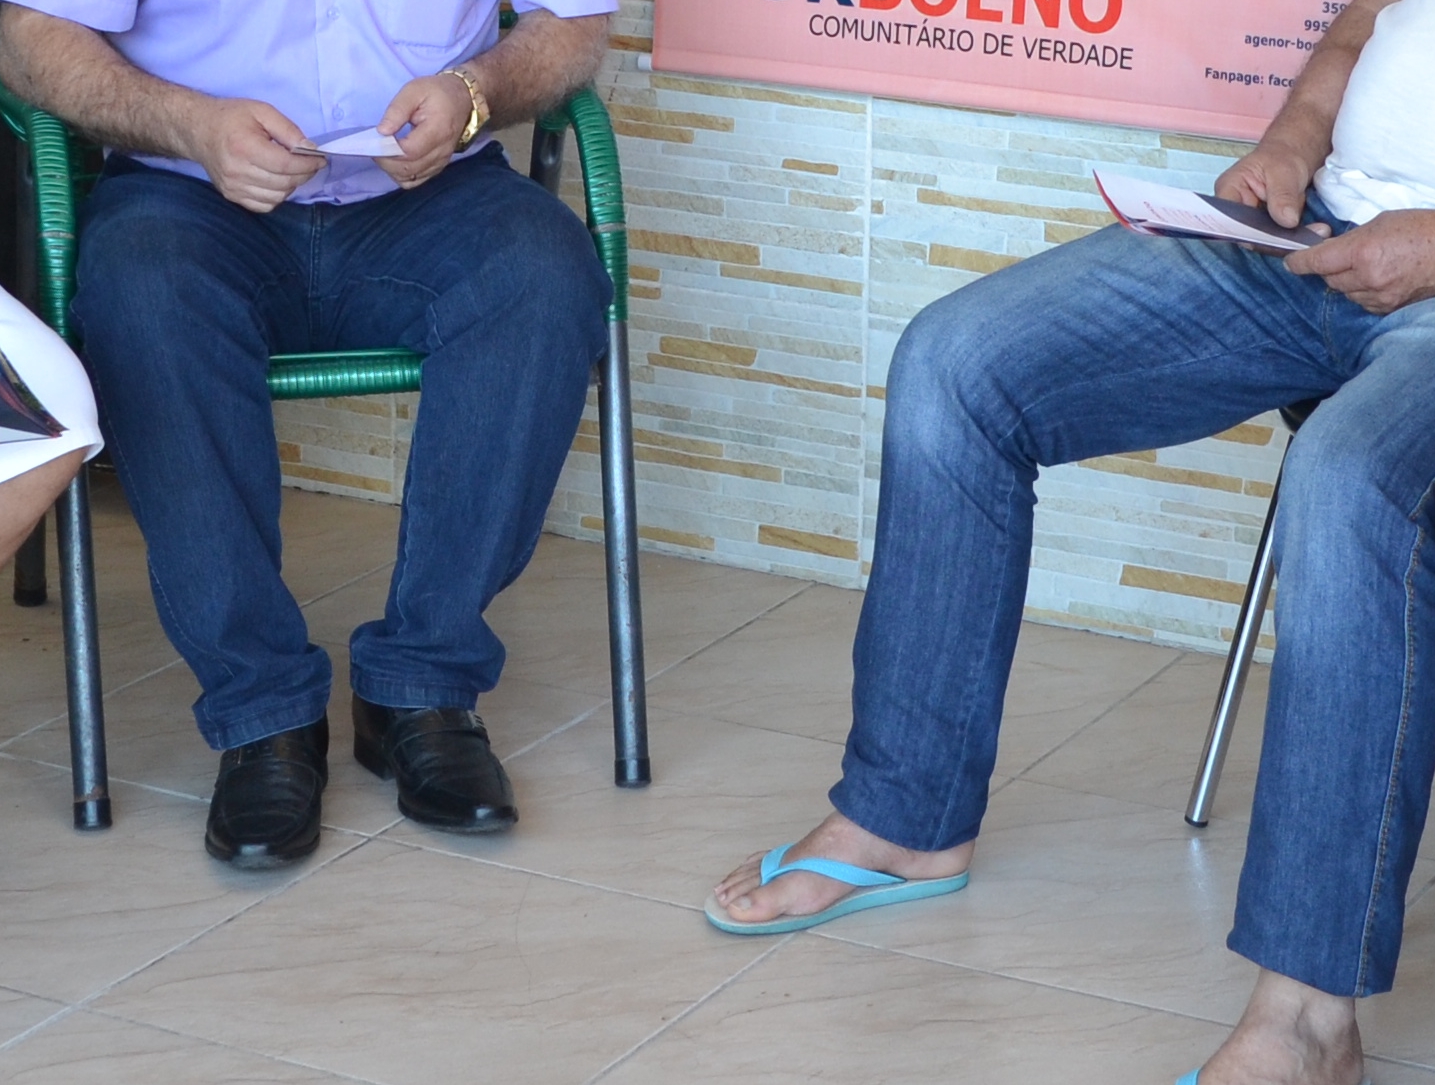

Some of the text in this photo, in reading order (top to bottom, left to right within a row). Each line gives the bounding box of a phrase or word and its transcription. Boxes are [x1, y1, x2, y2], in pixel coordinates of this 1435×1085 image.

[808, 14, 1134, 70] COMUNITÁRIO DE VERDADE
[1204, 67, 1264, 86] Fanpage:
